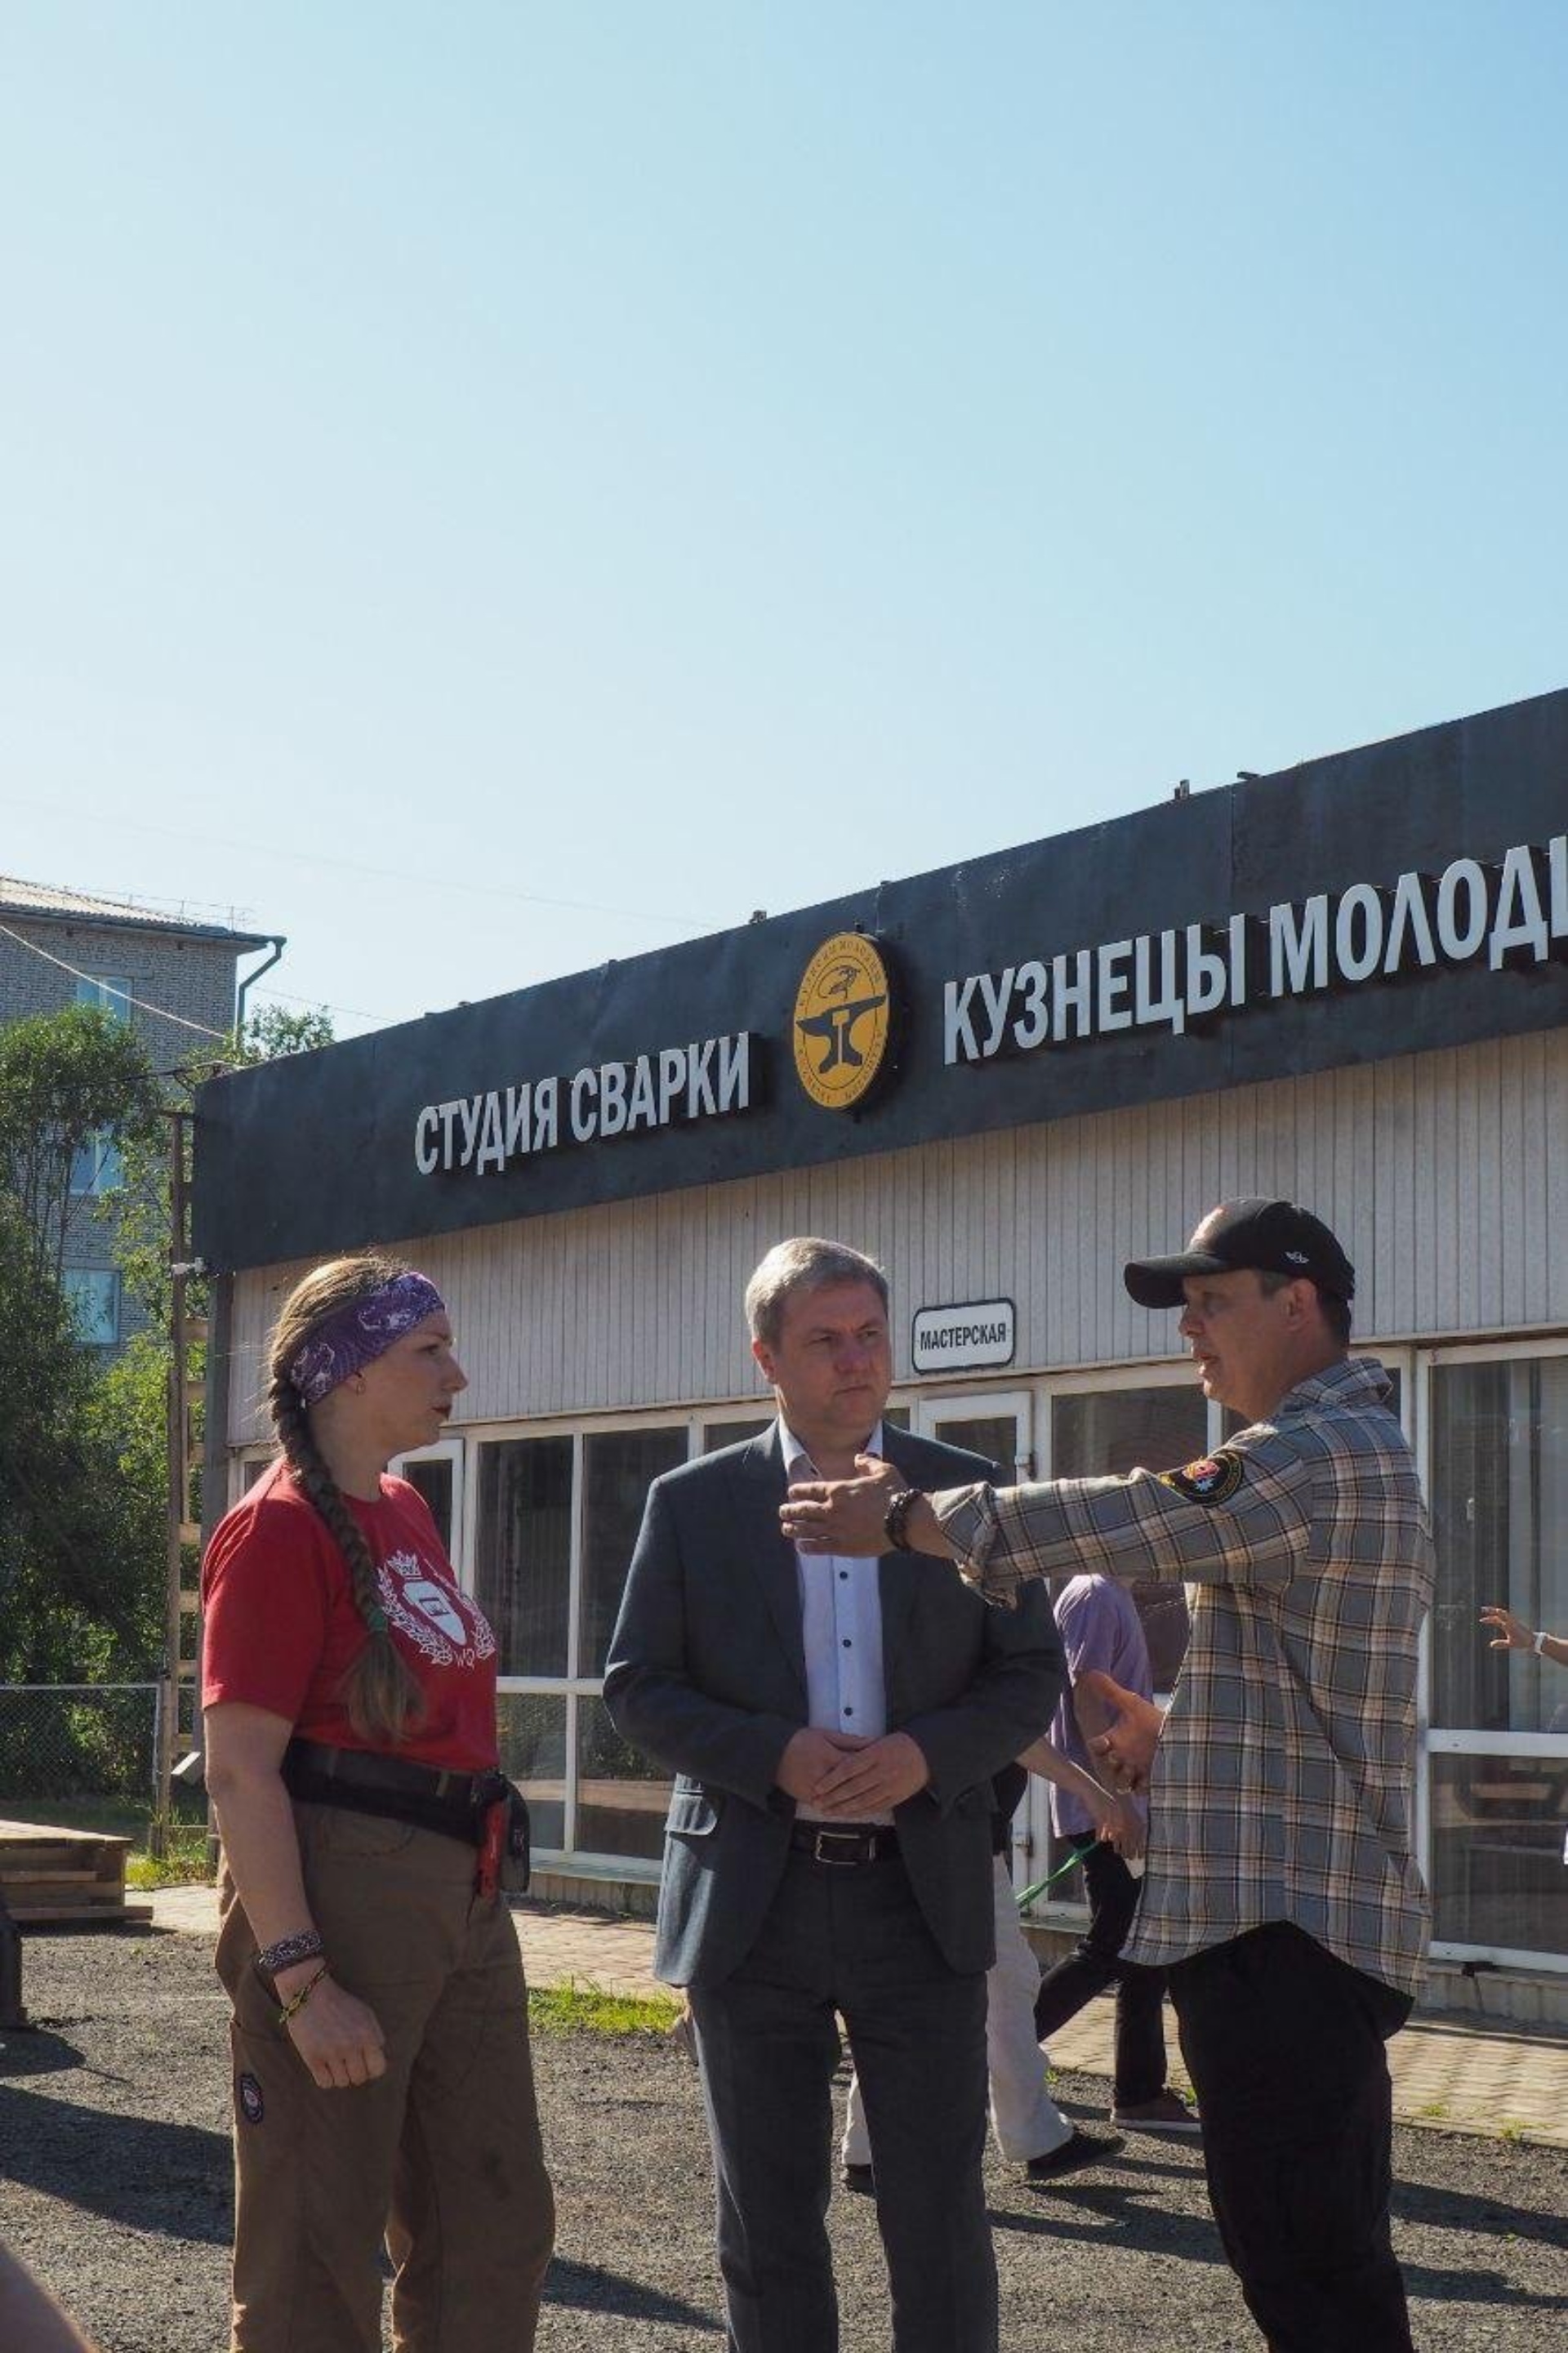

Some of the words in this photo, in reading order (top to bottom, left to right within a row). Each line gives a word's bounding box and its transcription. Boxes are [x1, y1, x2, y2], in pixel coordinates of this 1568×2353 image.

[945, 913, 1245, 1065] КУЗНЕЦЫ
[415, 1076, 558, 1174] СТУДИЯ
[571, 1031, 750, 1142] СВАРКИ
[920, 1323, 1006, 1351] МАСТЕРСКАЯ
